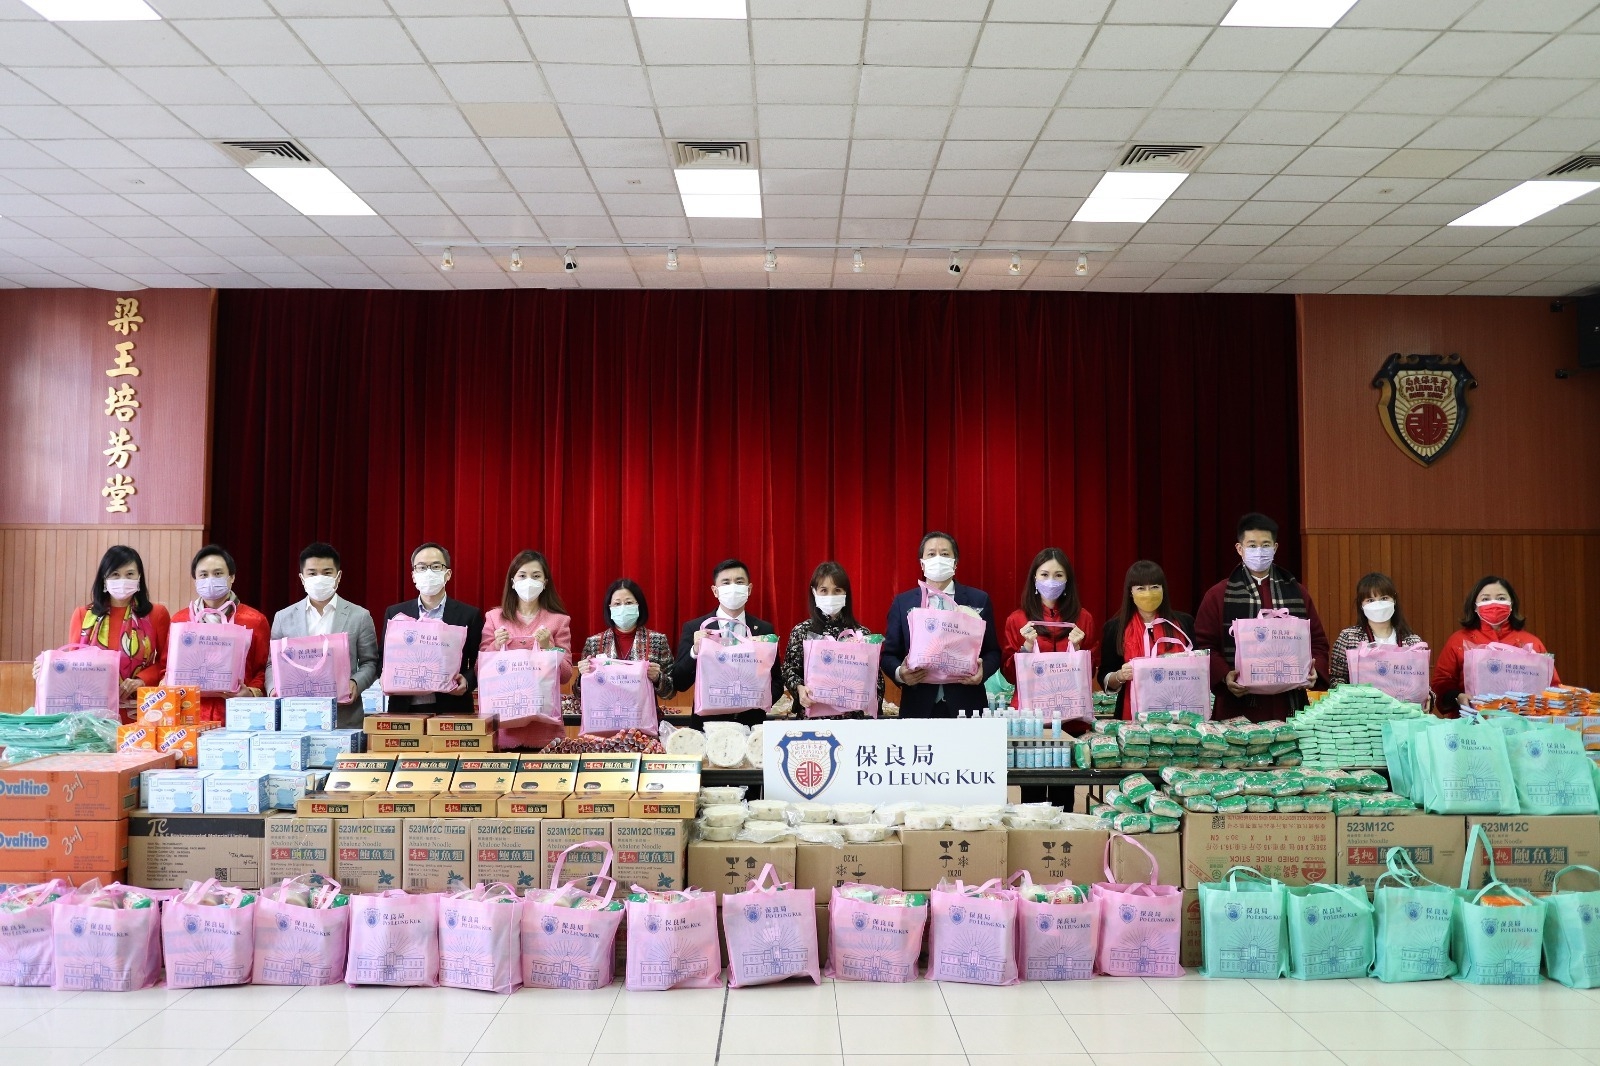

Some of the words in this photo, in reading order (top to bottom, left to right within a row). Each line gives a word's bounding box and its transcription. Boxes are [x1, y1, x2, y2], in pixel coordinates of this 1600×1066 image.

[101, 297, 144, 514] 梁王培芳堂
[855, 744, 934, 767] 保良局
[270, 824, 304, 832] 523M12C
[408, 825, 442, 834] 523M12C
[478, 826, 512, 834] 523M12C
[1346, 822, 1394, 832] 523M12C
[1481, 822, 1529, 832] 523M12C
[546, 828, 581, 836] 523M12C
[618, 828, 652, 836] 523M12C
[1514, 848, 1566, 864] 鮑魚麵
